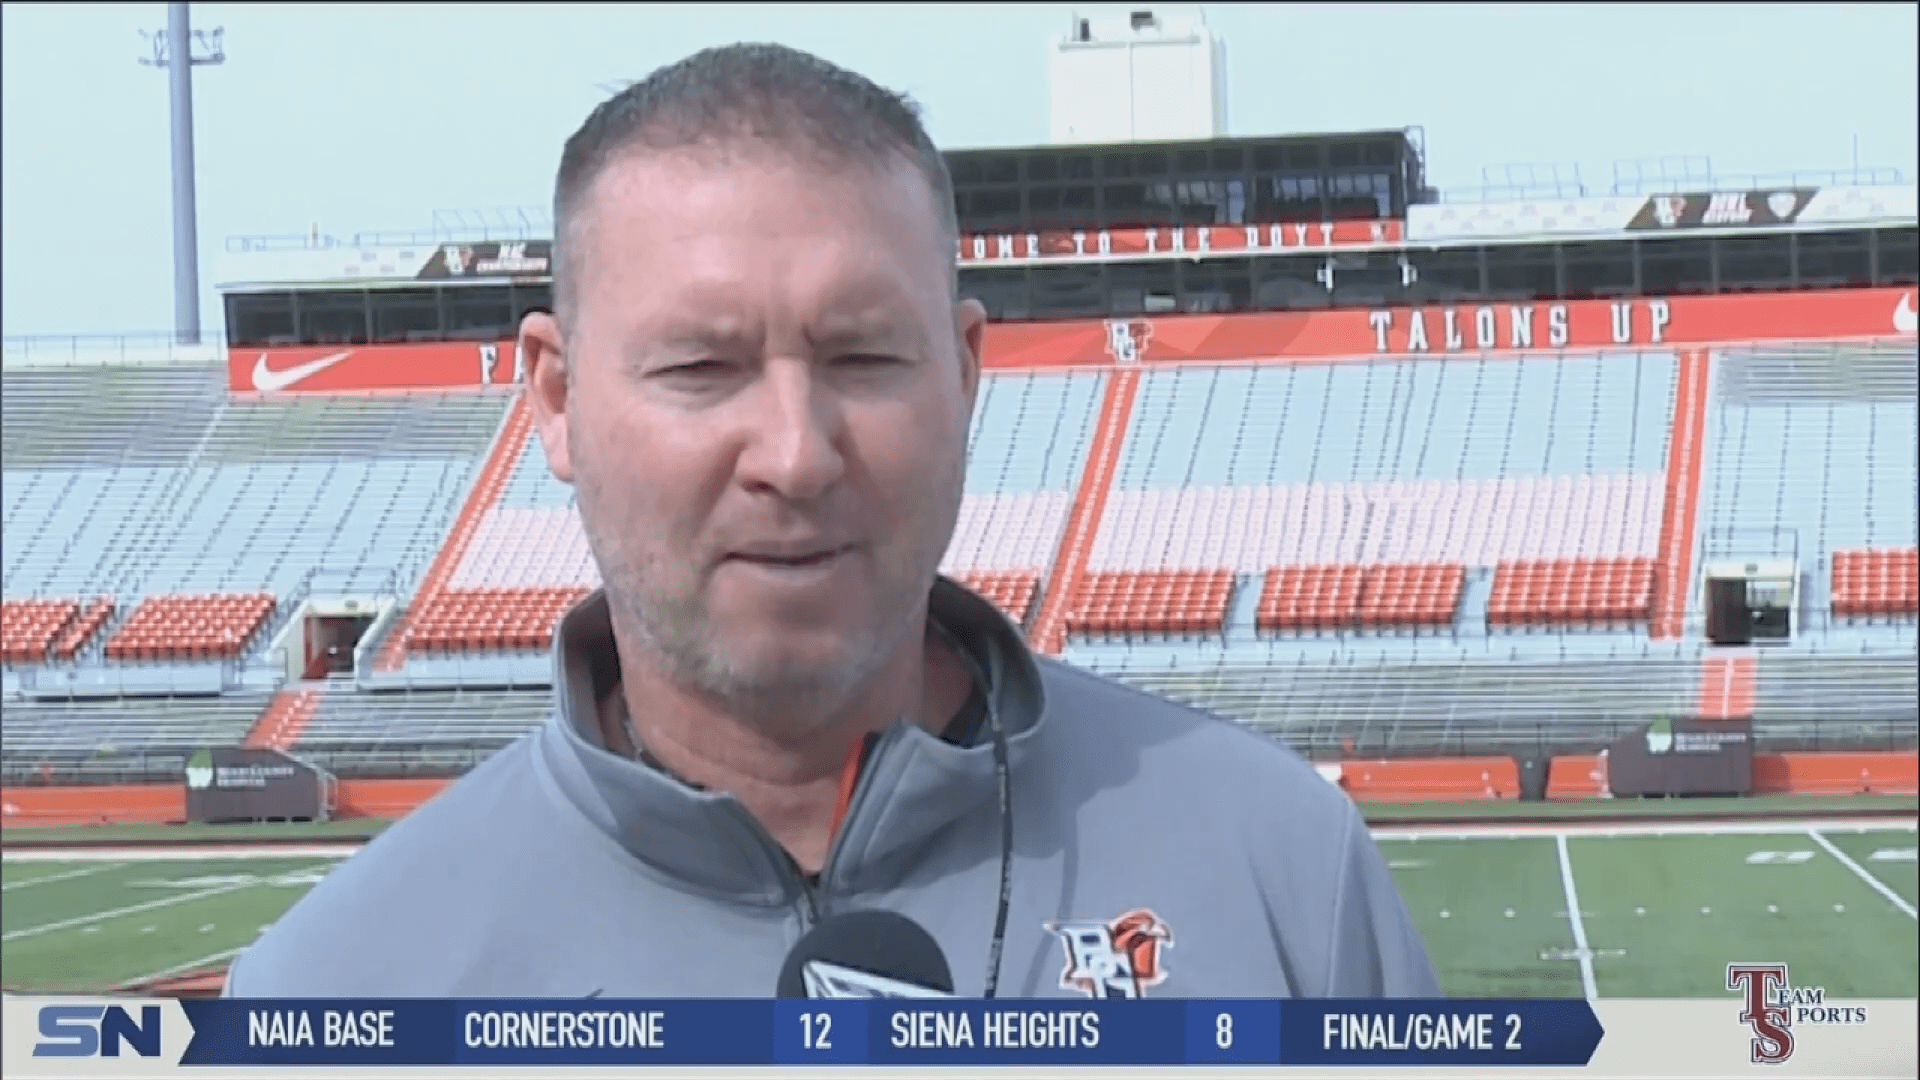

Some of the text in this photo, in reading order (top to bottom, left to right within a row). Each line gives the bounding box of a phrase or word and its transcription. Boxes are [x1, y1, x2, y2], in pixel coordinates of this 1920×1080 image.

[957, 221, 1335, 259] OME TO THE DOYT
[1369, 299, 1672, 351] TALONS UP
